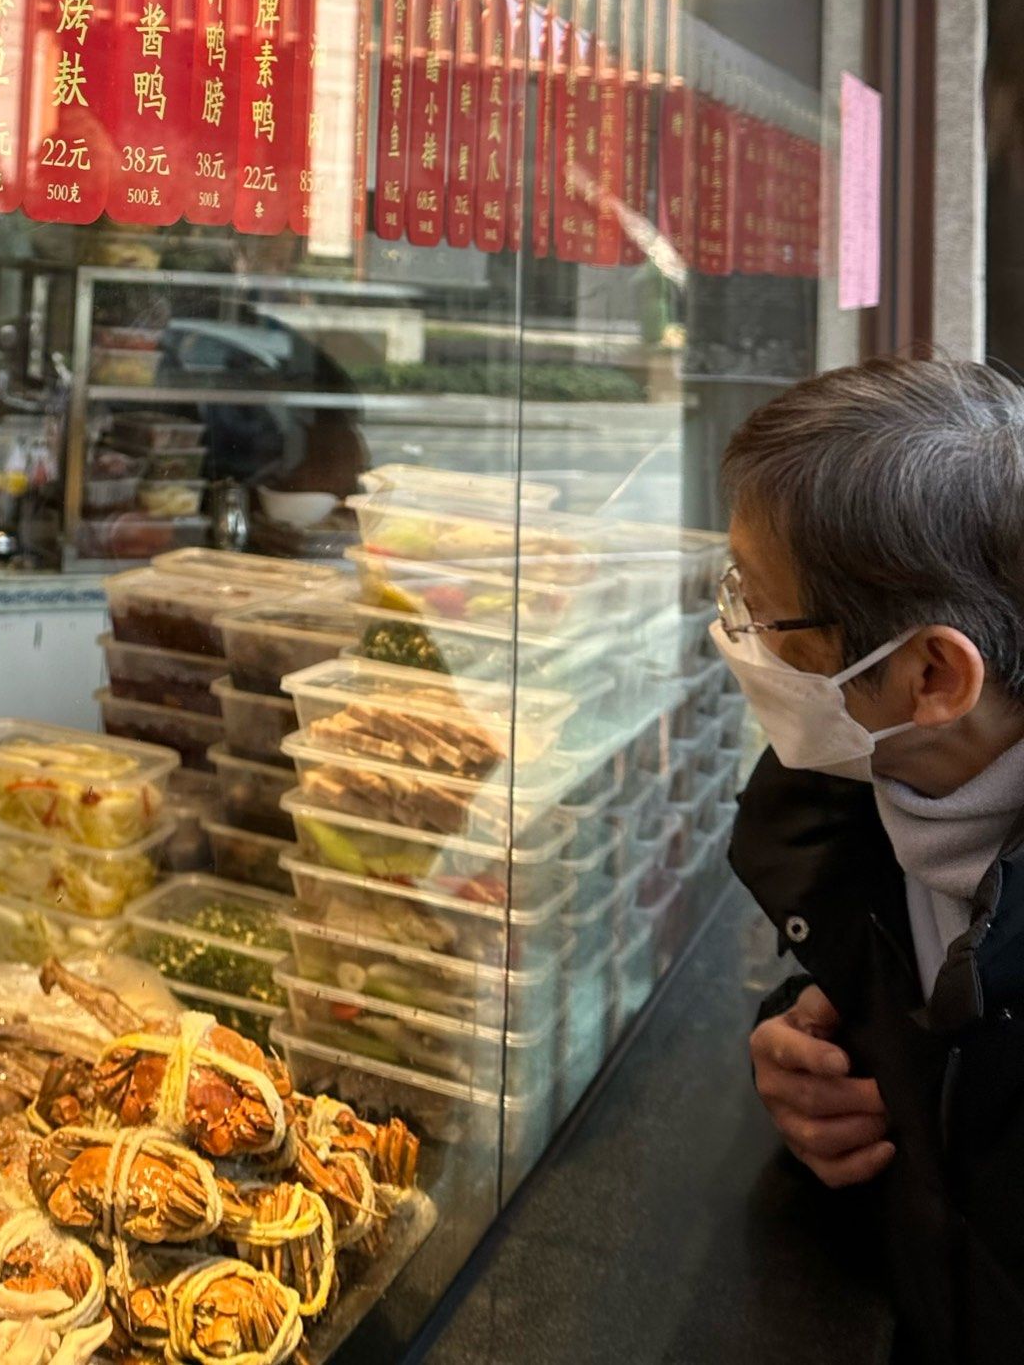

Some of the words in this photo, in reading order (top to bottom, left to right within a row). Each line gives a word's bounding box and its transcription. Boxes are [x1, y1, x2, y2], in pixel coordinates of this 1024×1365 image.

[40, 137, 92, 171] 22元
[120, 145, 171, 176] 38元
[194, 150, 226, 181] 38元
[46, 182, 82, 204] 500克
[243, 165, 278, 193] 22元
[126, 186, 162, 207] 500克
[198, 191, 221, 209] 500克
